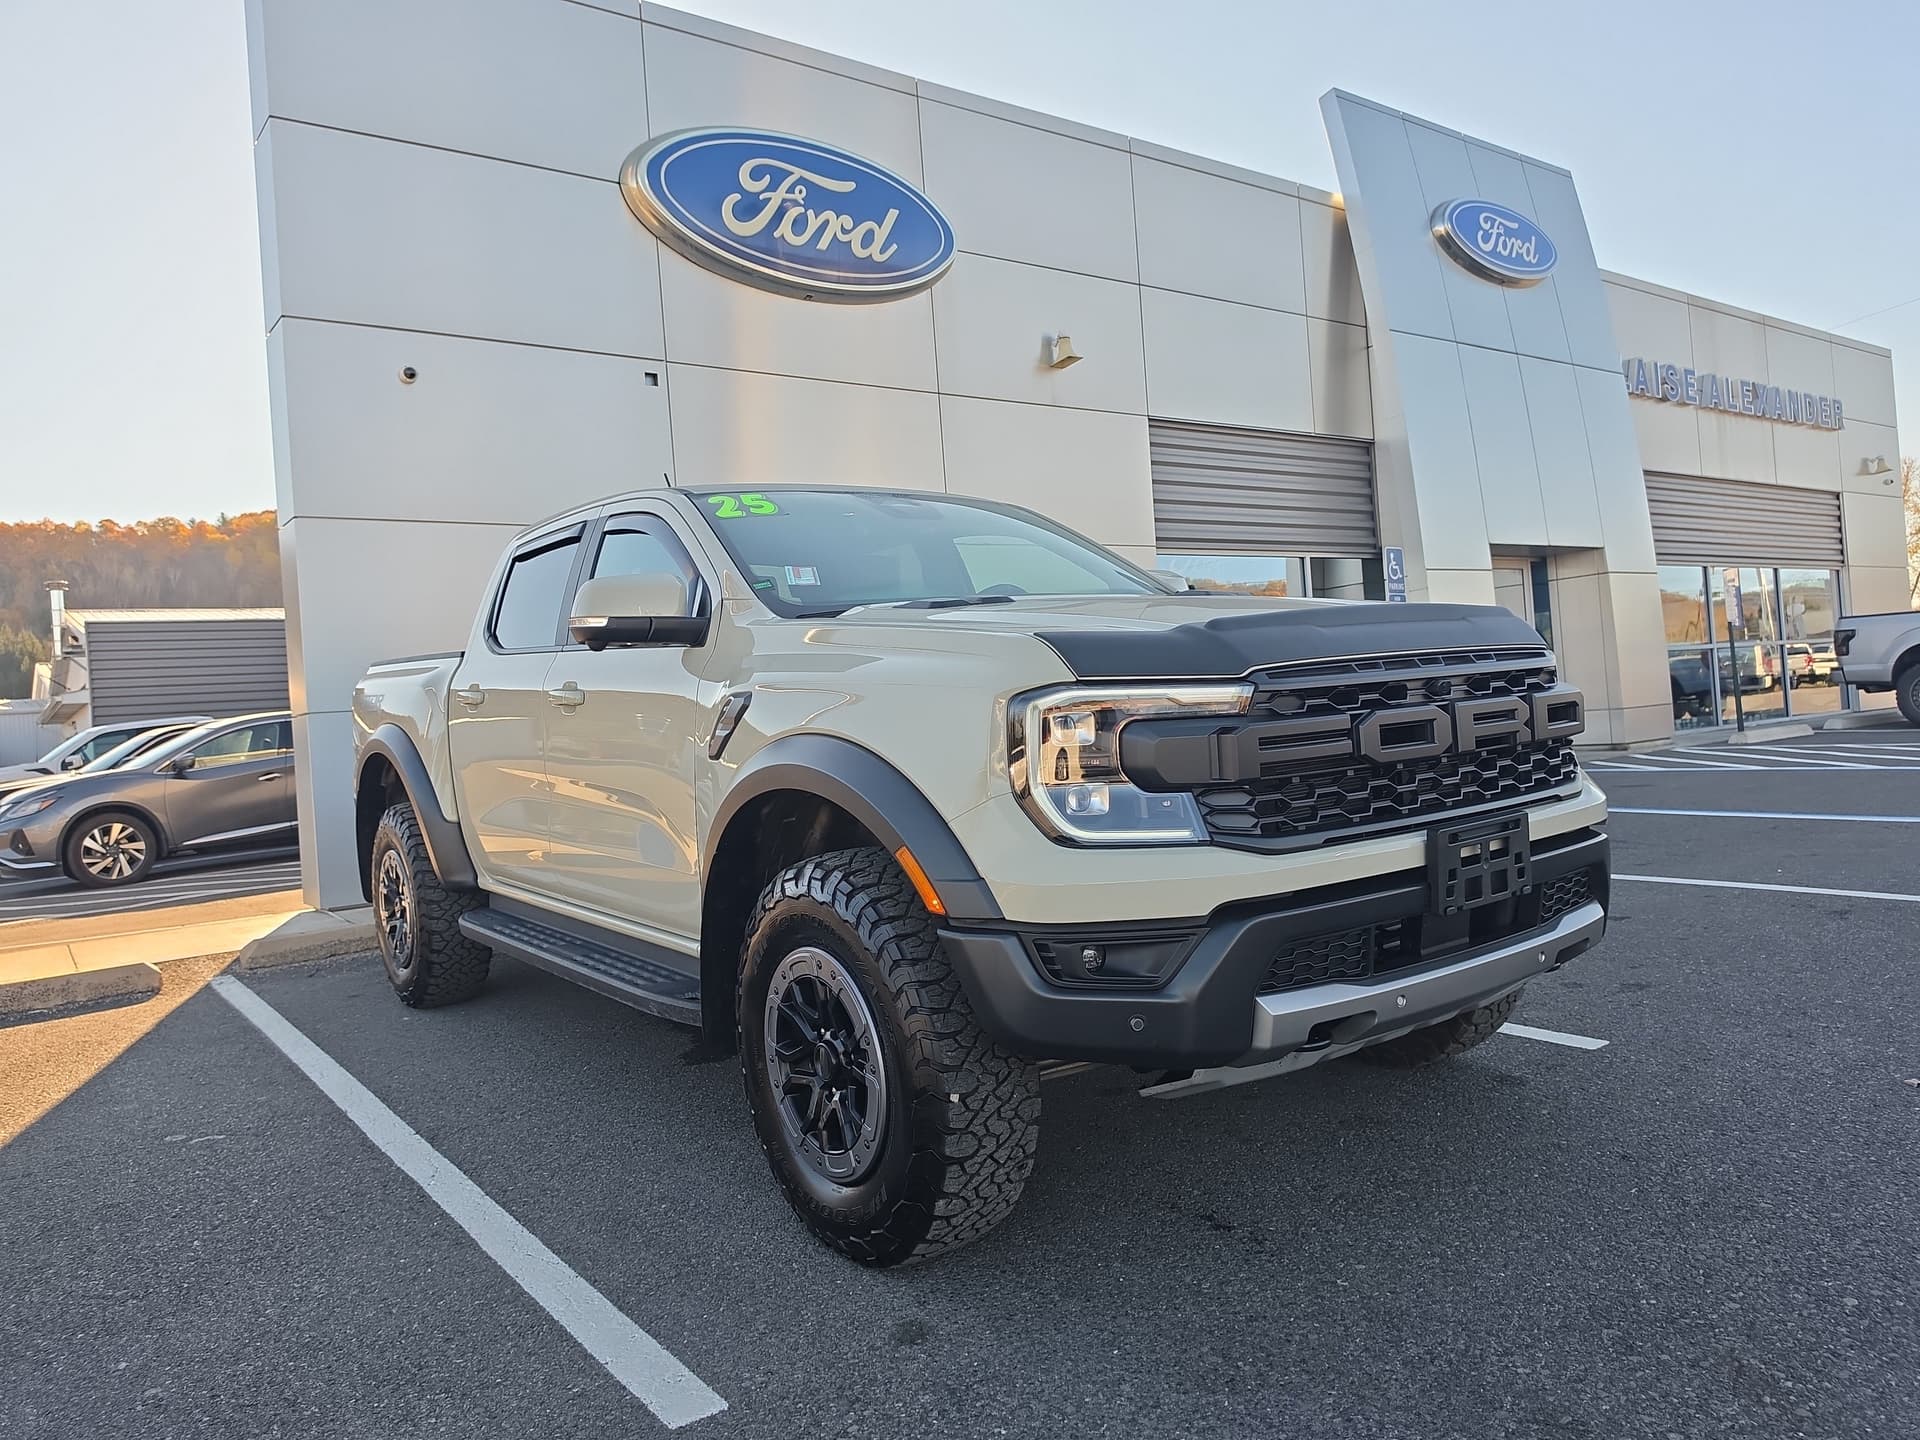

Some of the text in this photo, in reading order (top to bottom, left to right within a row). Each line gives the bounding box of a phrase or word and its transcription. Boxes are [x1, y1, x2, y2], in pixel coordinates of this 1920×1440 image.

[721, 158, 899, 263] Ford
[1477, 213, 1539, 264] Ford
[1700, 373, 1844, 431] ALEXANDER
[708, 492, 778, 519] 25
[1218, 684, 1585, 782] FORD
